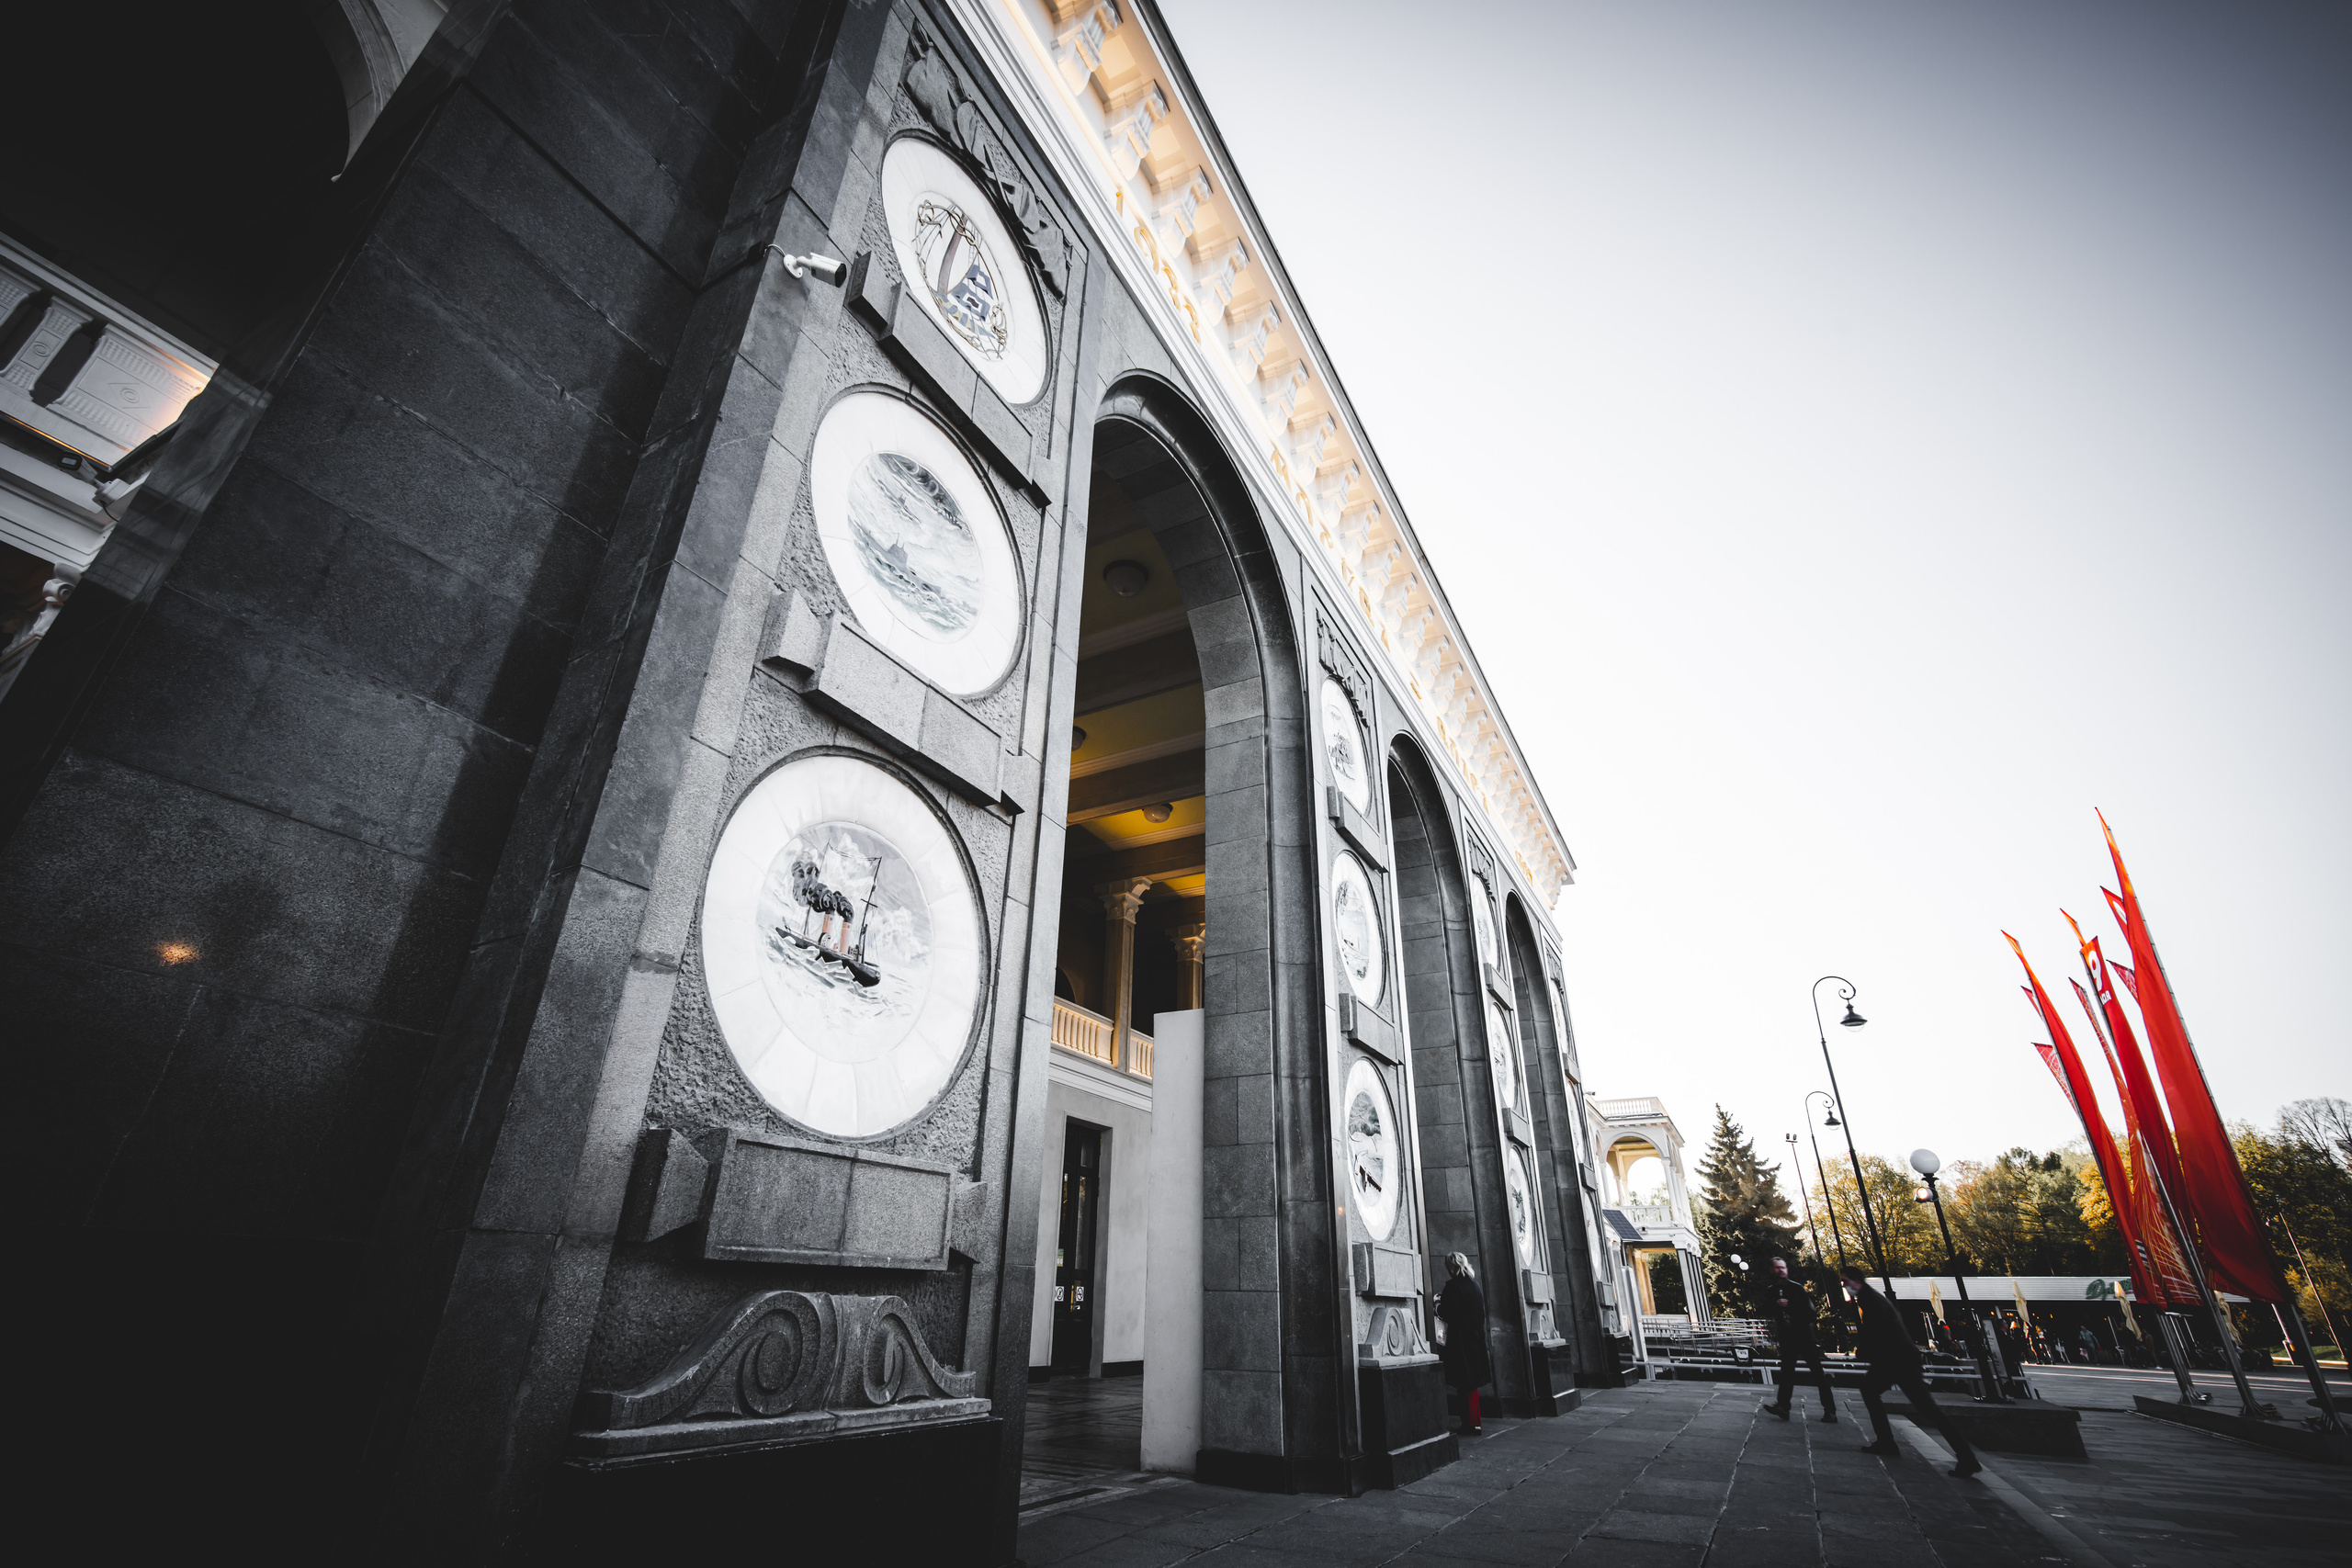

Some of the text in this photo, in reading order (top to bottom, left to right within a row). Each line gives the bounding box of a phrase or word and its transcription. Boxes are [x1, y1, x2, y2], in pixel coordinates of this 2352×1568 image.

[1115, 190, 1201, 346] 1933
[1270, 447, 1391, 655] МОСКВА
[1436, 715, 1490, 816] ВОЛГА
[2088, 950, 2103, 991] 9
